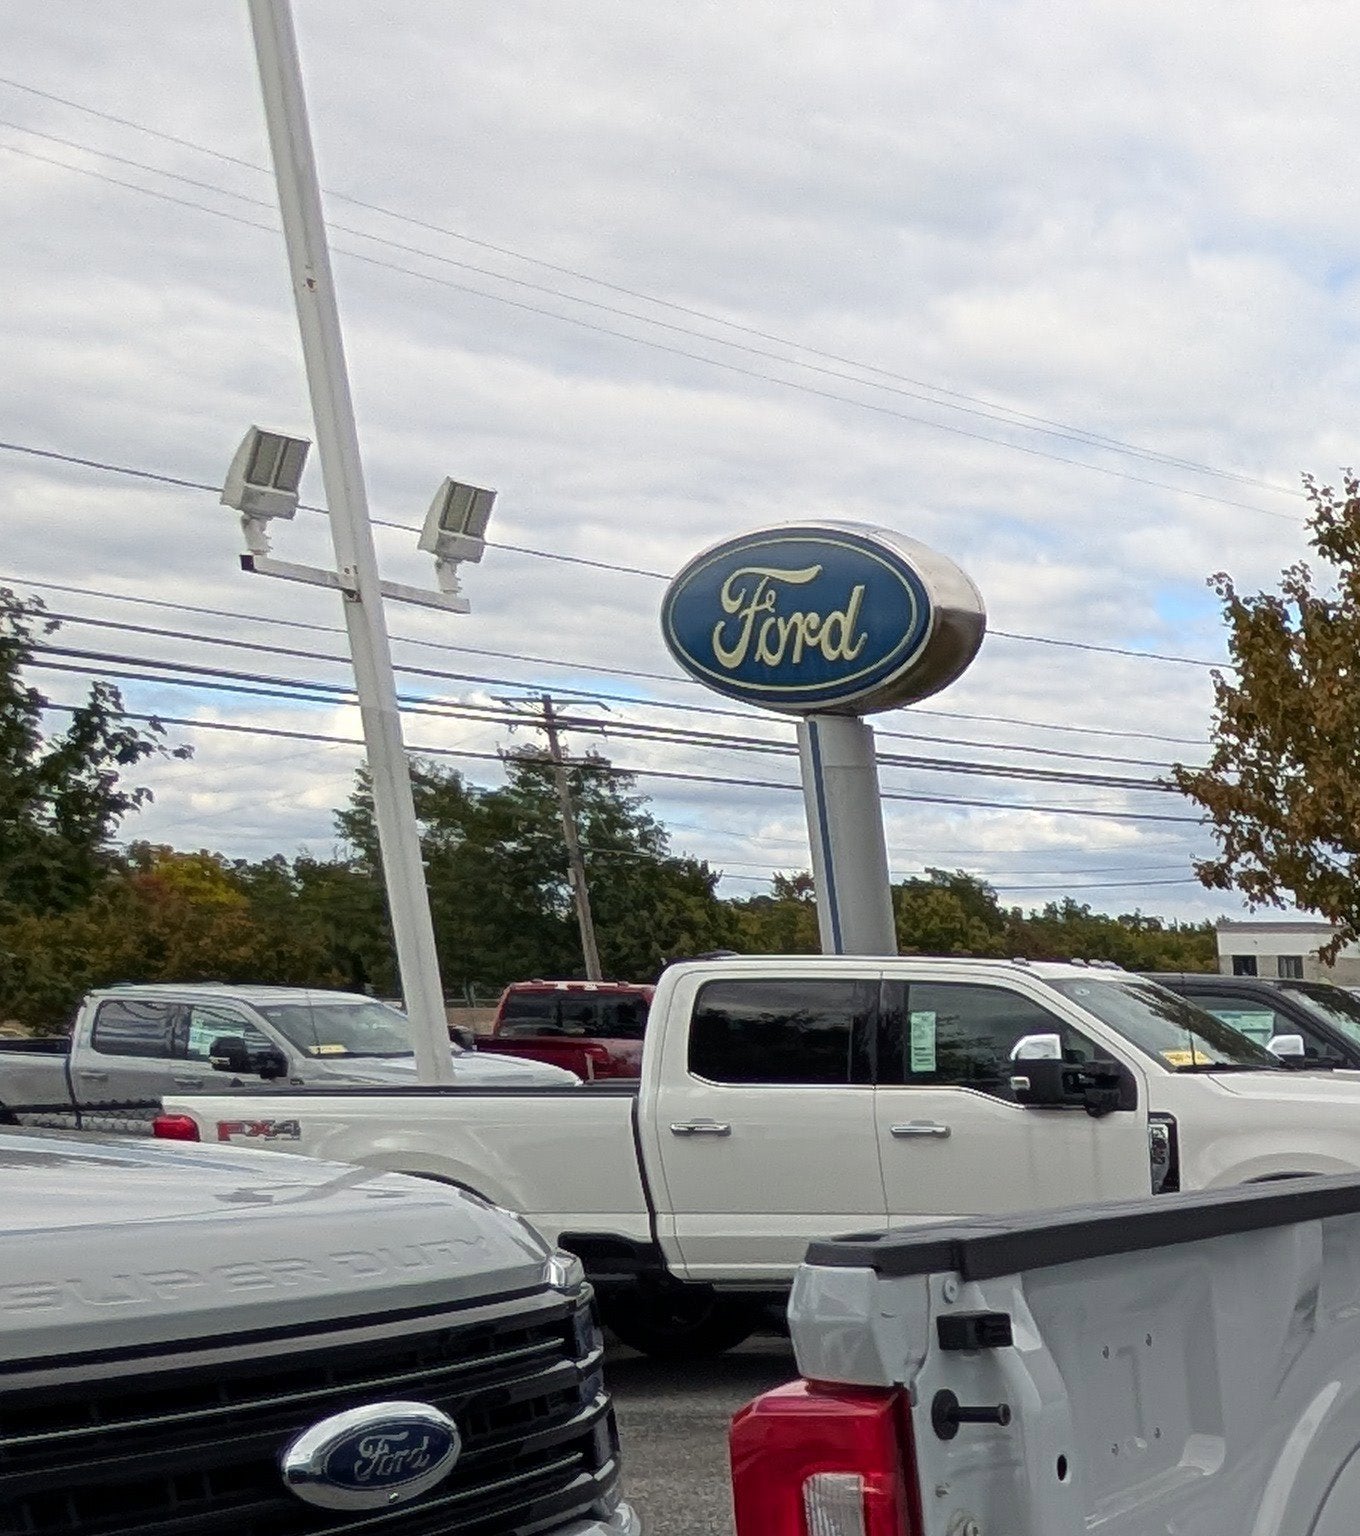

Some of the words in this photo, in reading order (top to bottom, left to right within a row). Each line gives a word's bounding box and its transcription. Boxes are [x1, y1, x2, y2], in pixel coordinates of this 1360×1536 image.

[712, 564, 868, 669] Ford
[217, 1119, 301, 1141] FX4
[329, 1235, 495, 1278] DUTY
[353, 1431, 431, 1481] Ford
